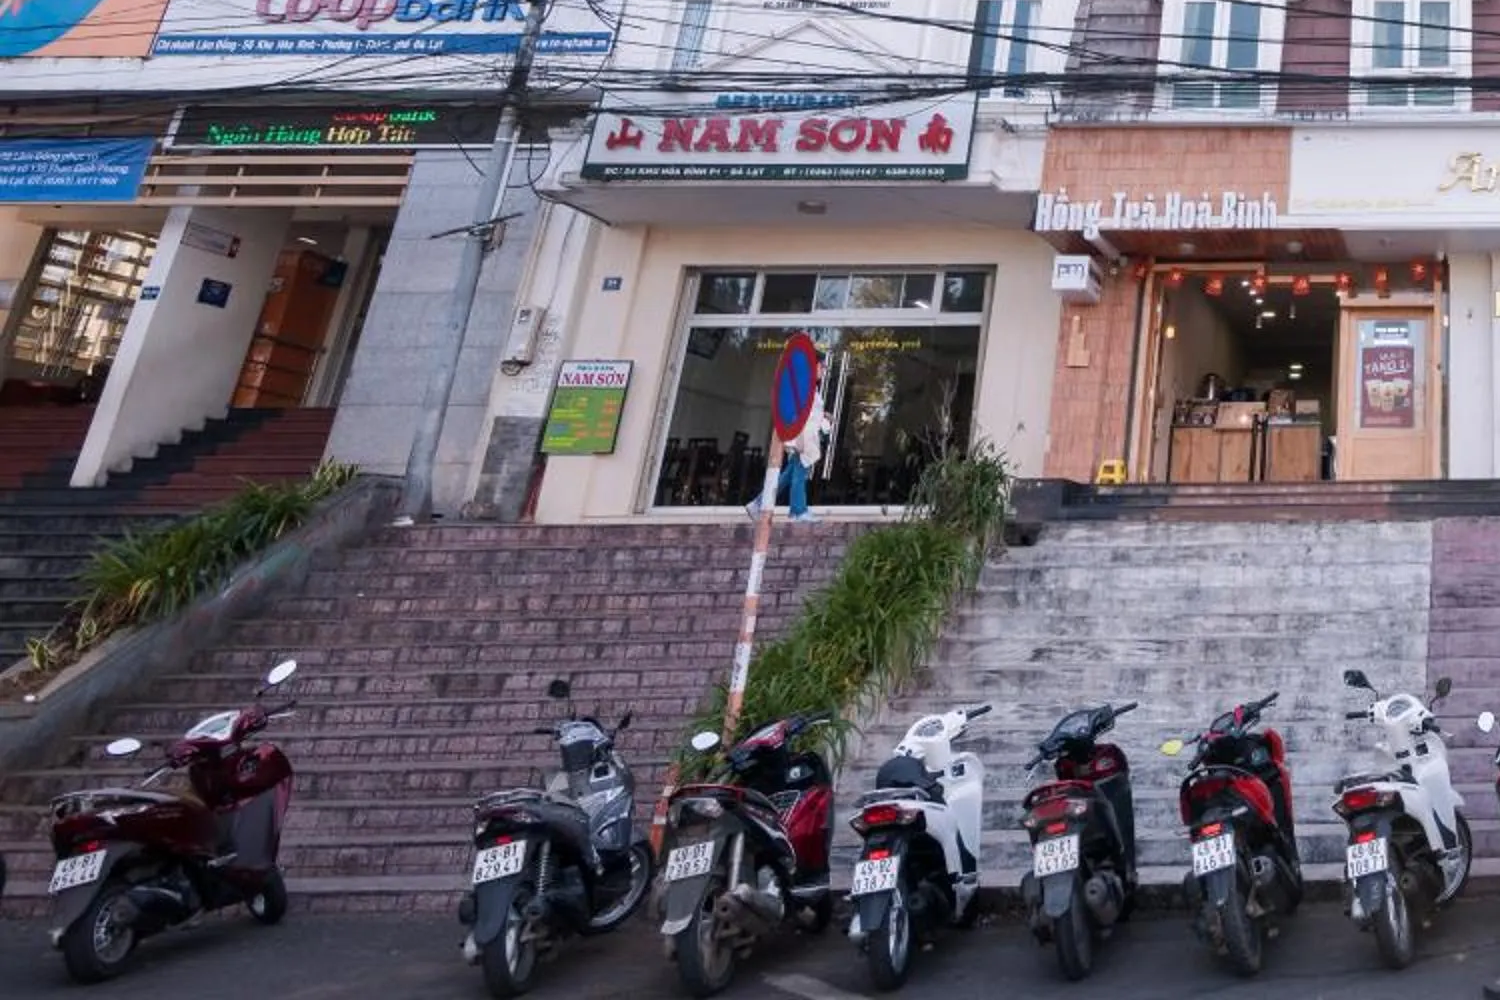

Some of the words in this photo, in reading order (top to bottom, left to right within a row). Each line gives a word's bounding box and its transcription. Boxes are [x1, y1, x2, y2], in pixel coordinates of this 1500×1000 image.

[264, 124, 322, 146] Hàng
[327, 123, 373, 146] Hợp
[657, 118, 785, 152] NAM
[1035, 187, 1101, 237] Hồng
[561, 372, 594, 385] NAM
